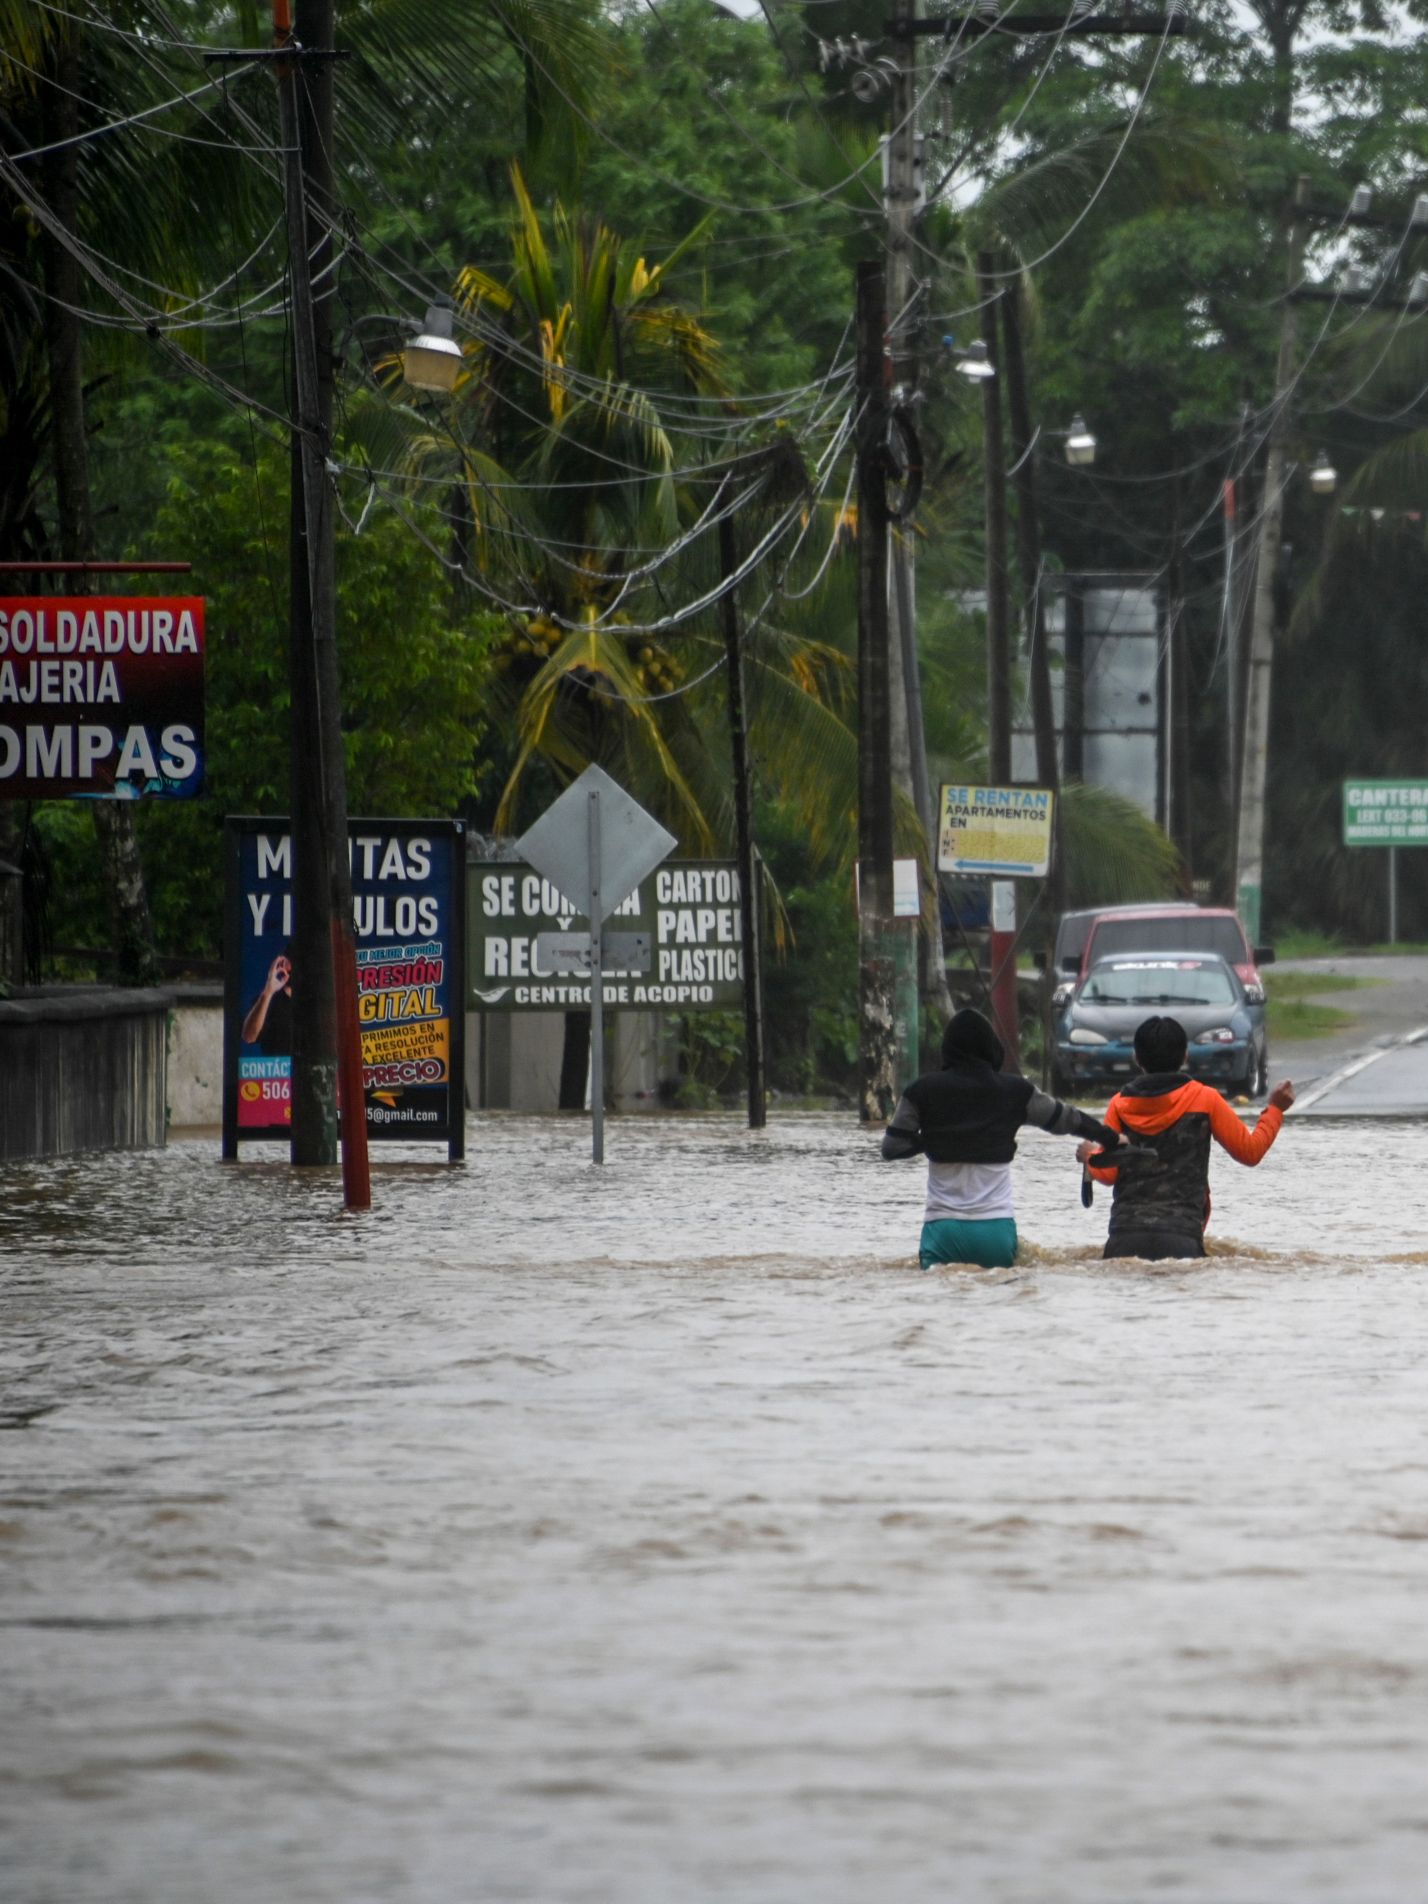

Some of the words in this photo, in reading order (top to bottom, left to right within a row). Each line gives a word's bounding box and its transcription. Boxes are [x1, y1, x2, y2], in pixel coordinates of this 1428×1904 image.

[947, 787, 968, 803] SE
[974, 789, 1048, 808] RENTAN
[945, 805, 1046, 821] APARTAMENTOS
[950, 817, 967, 829] EN
[256, 835, 431, 881] MTAS
[482, 875, 515, 917] SE
[522, 875, 641, 917] COA
[248, 894, 271, 937] Y
[282, 894, 439, 937] ULOS
[556, 917, 573, 931] Y
[369, 947, 402, 961] MEJOR
[358, 987, 441, 1021] GITAL
[602, 986, 629, 1003] DE
[633, 985, 714, 1003] ACOPIO
[420, 1022, 435, 1032] EN
[375, 1031, 444, 1052] RESOLUCIÓN
[371, 1045, 436, 1064] EXCELENTE
[362, 1059, 440, 1087] PRECIO
